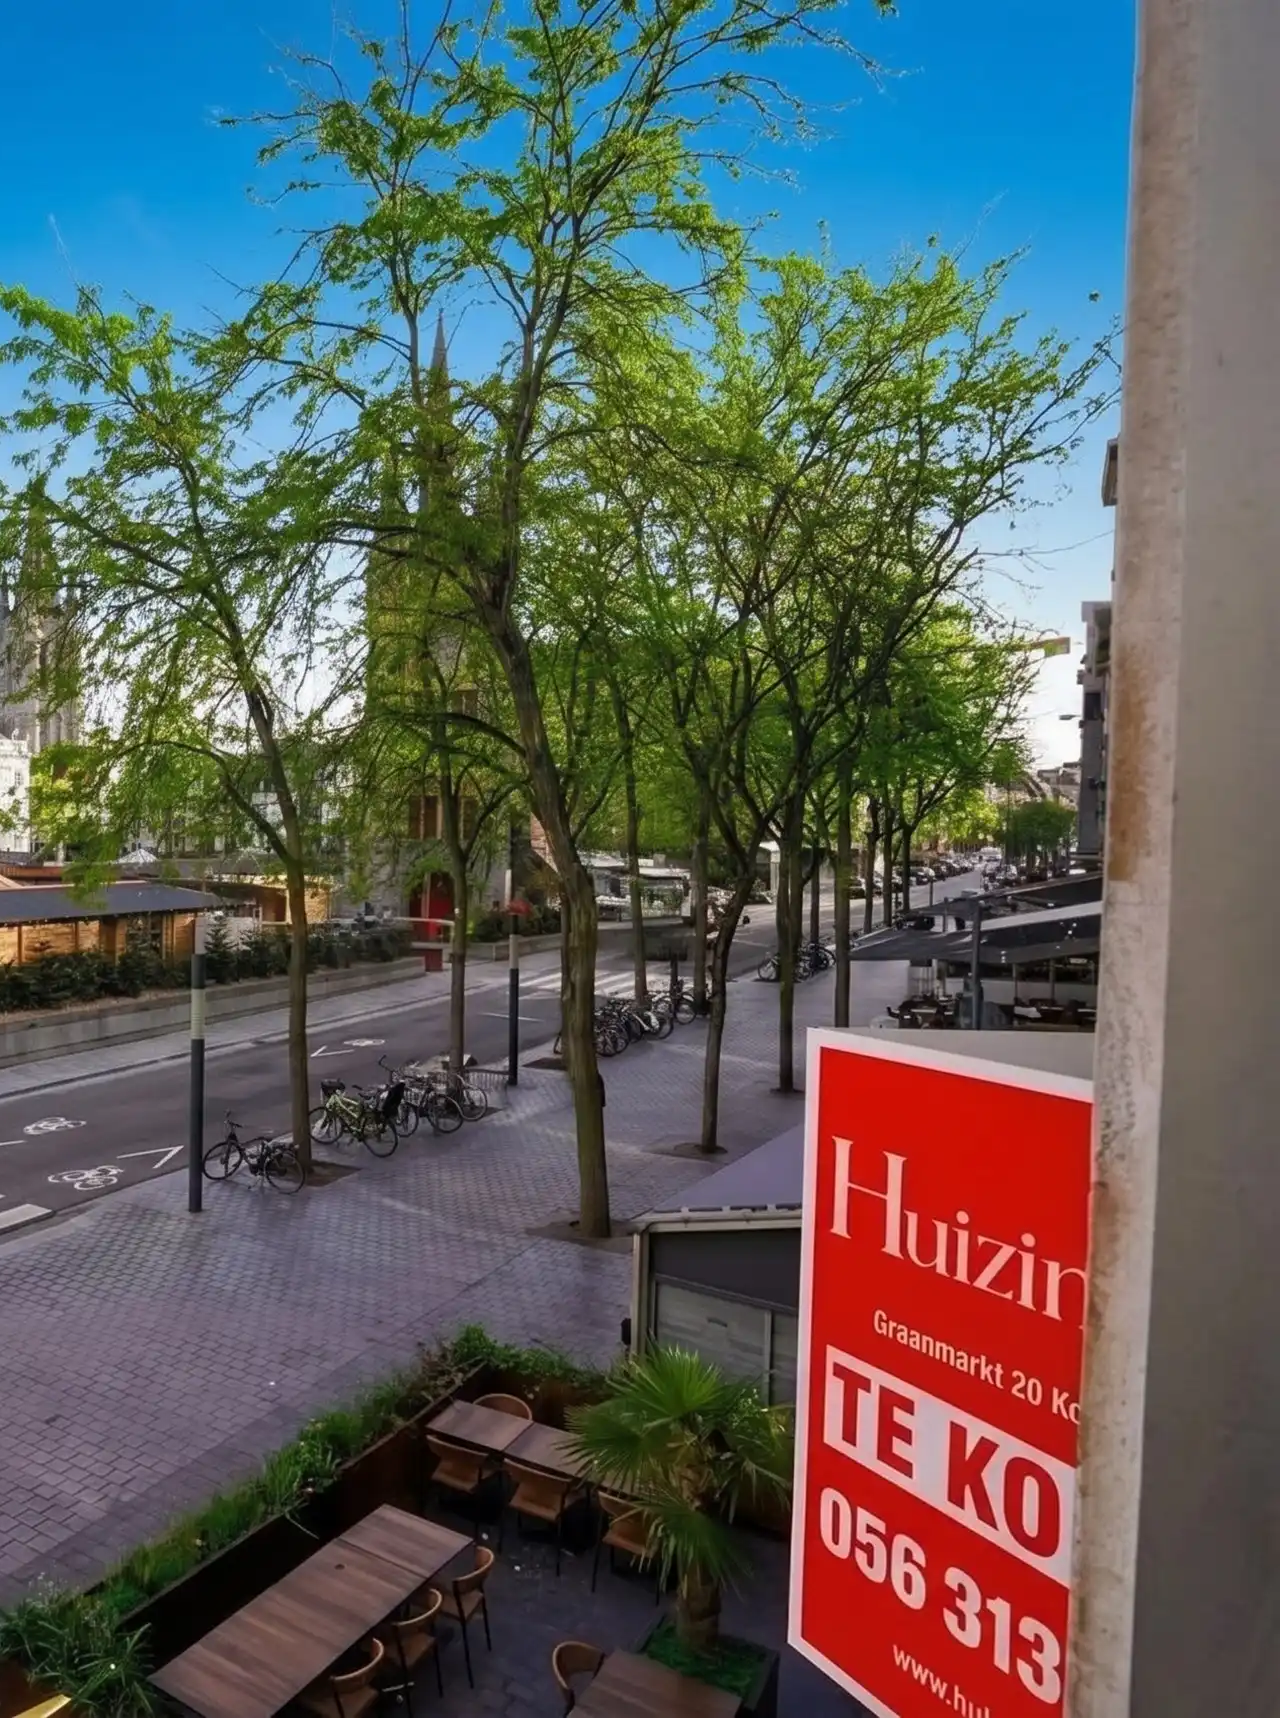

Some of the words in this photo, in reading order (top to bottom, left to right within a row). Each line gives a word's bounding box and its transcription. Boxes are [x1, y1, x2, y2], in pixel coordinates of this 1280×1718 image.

[830, 1135, 1088, 1329] Huizin
[873, 1309, 1005, 1389] Graanmarkt
[1011, 1370, 1043, 1406] 20
[832, 1361, 916, 1479] TE
[946, 1420, 1062, 1559] KO
[820, 1487, 927, 1611] 056
[943, 1565, 1062, 1705] 313
